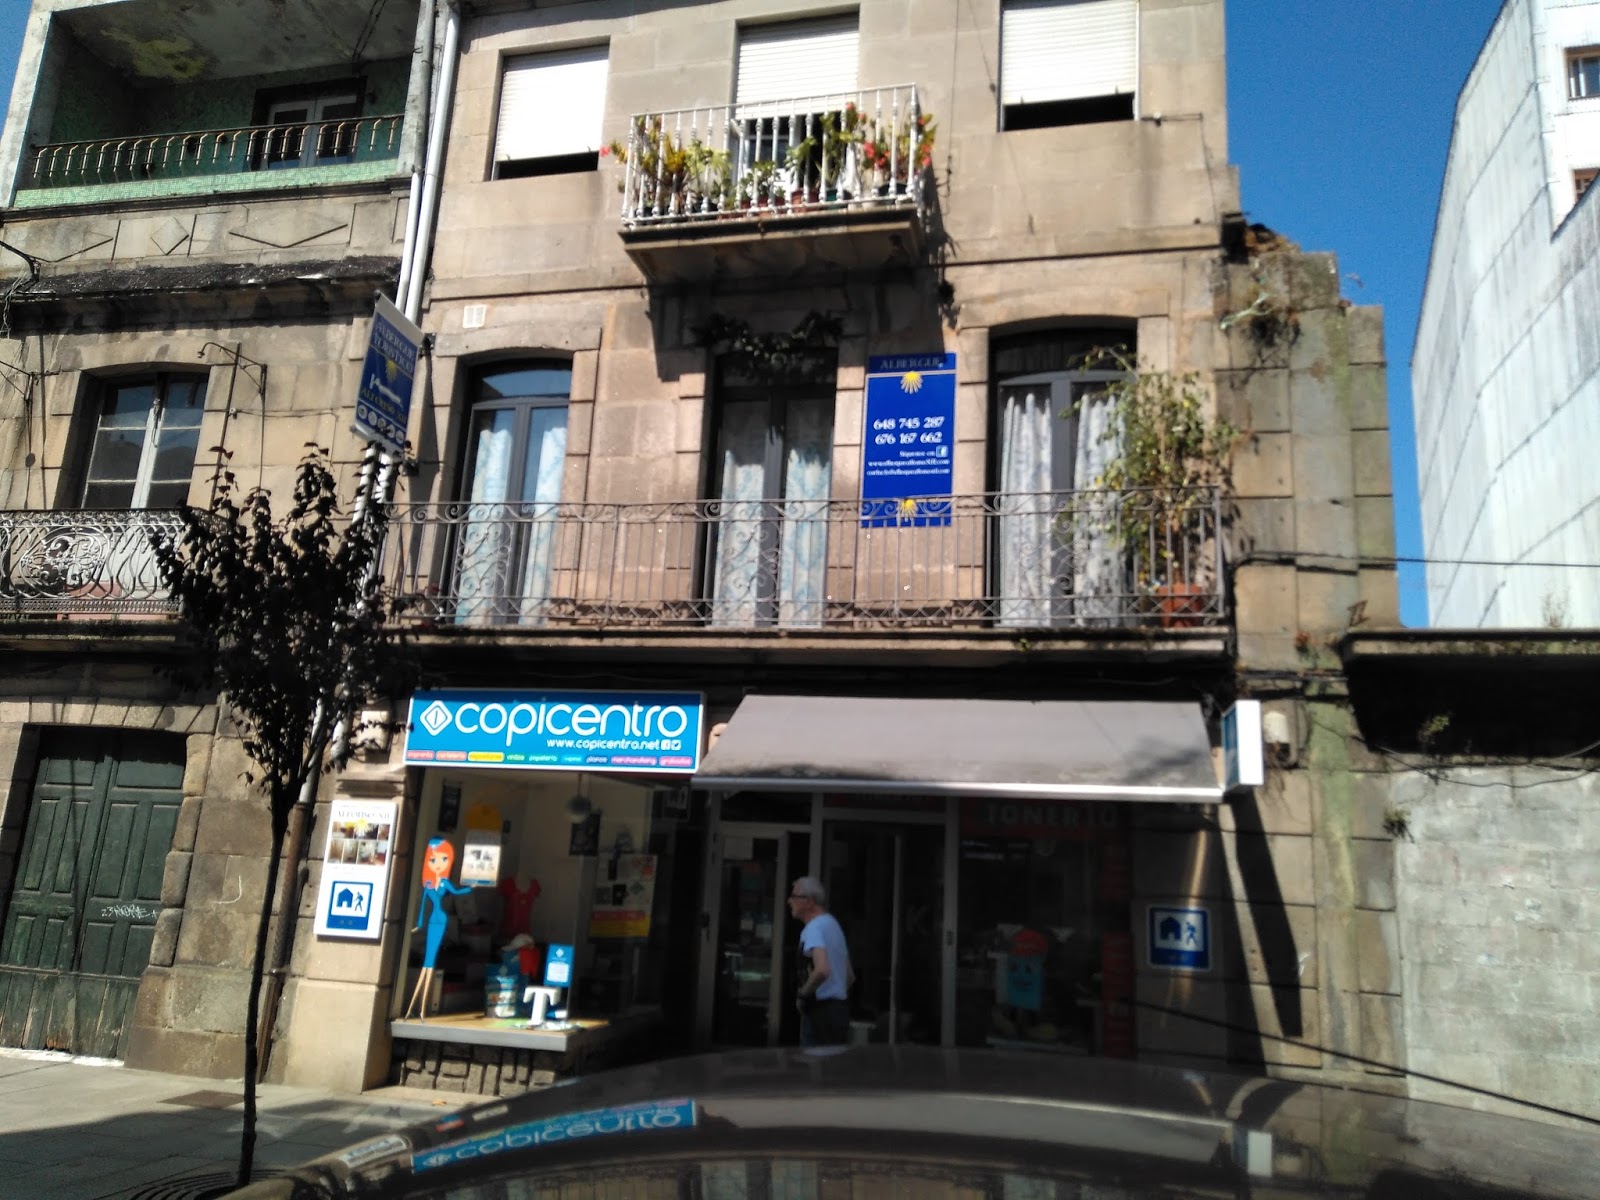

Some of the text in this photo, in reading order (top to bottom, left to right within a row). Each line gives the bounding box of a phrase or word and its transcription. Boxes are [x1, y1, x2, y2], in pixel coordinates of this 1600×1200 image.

[873, 416, 945, 430] 648 745 287
[875, 431, 942, 445] 676 167 662
[455, 702, 688, 747] copicentro
[546, 738, 660, 751] www.copicentro.net
